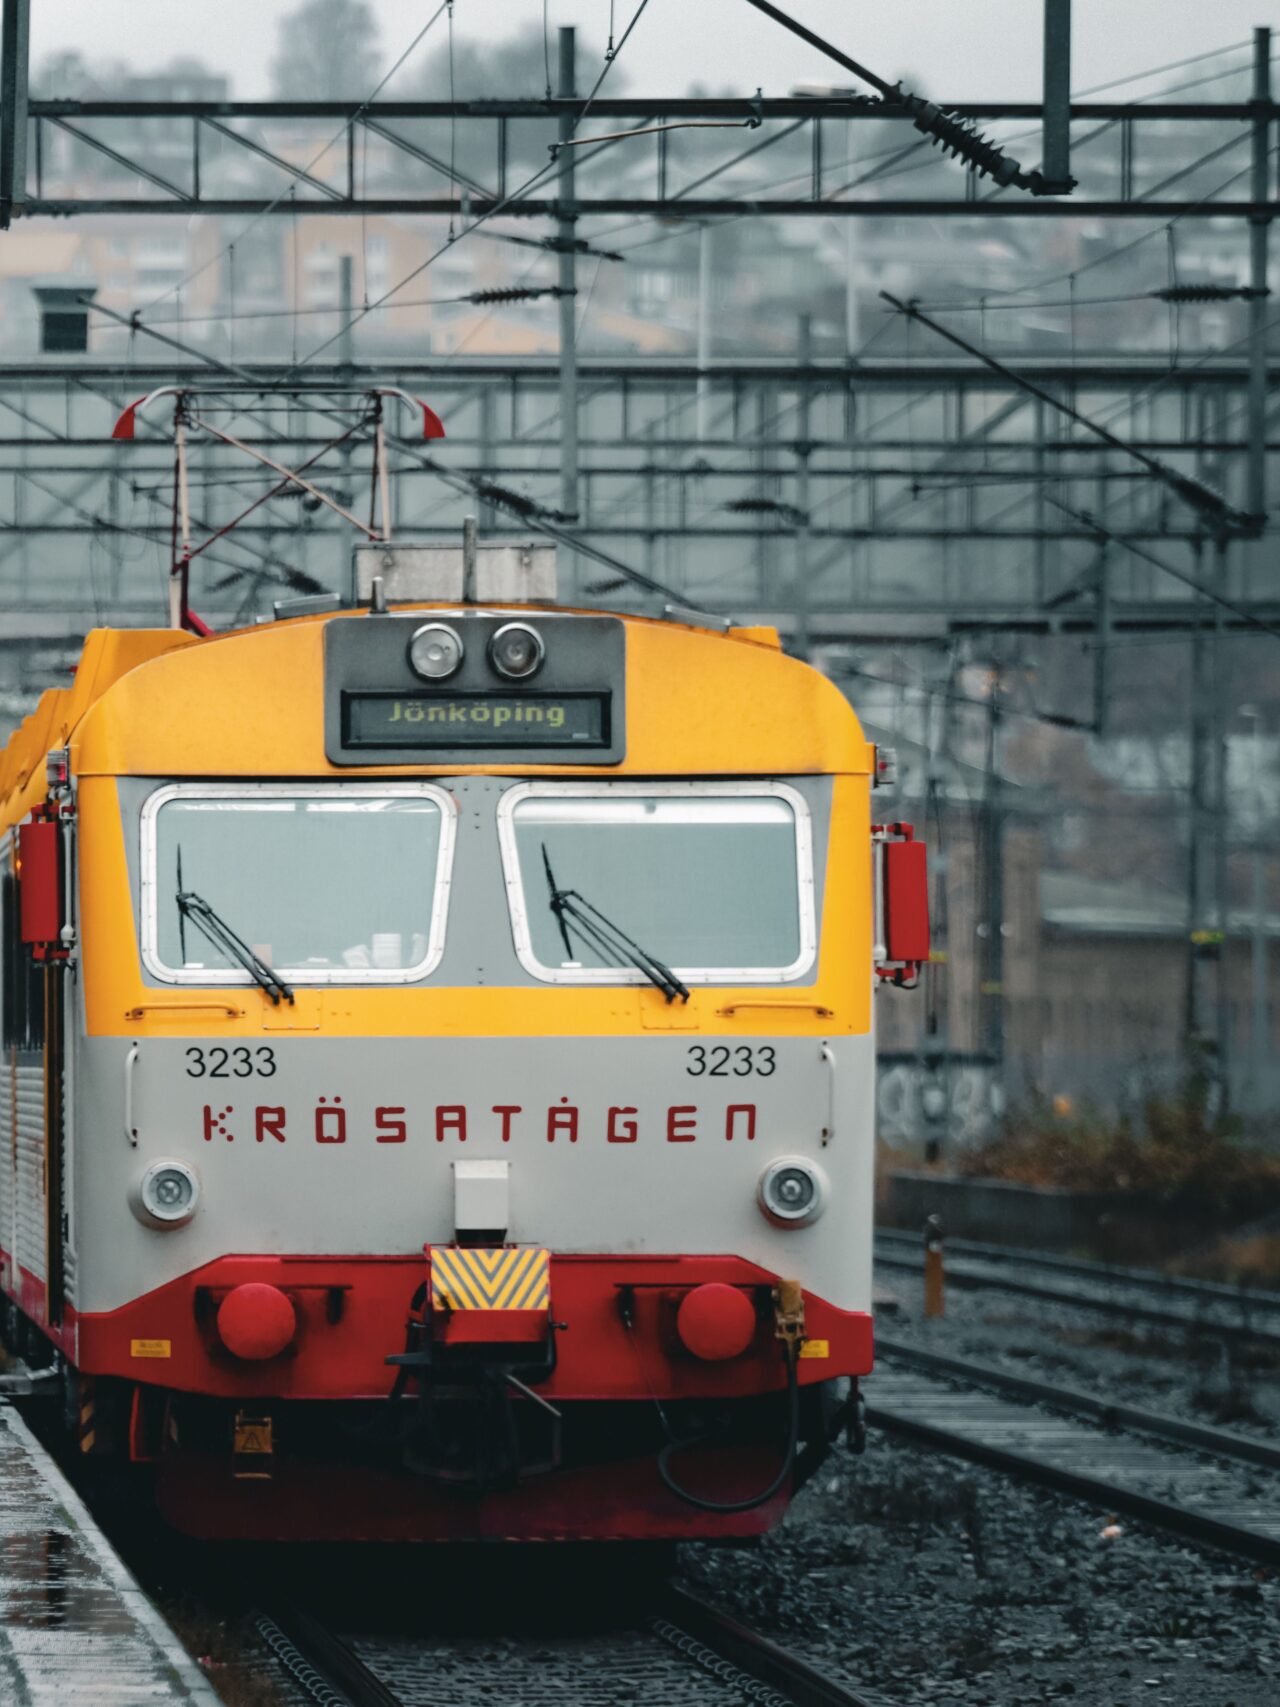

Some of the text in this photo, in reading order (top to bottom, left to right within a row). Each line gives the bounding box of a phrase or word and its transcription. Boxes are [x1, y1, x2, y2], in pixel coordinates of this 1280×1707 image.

[388, 702, 565, 727] Jönköping
[185, 1047, 277, 1077] 3233
[686, 1046, 776, 1076] 3233
[203, 1096, 757, 1143] KRÖSATÅGEN
